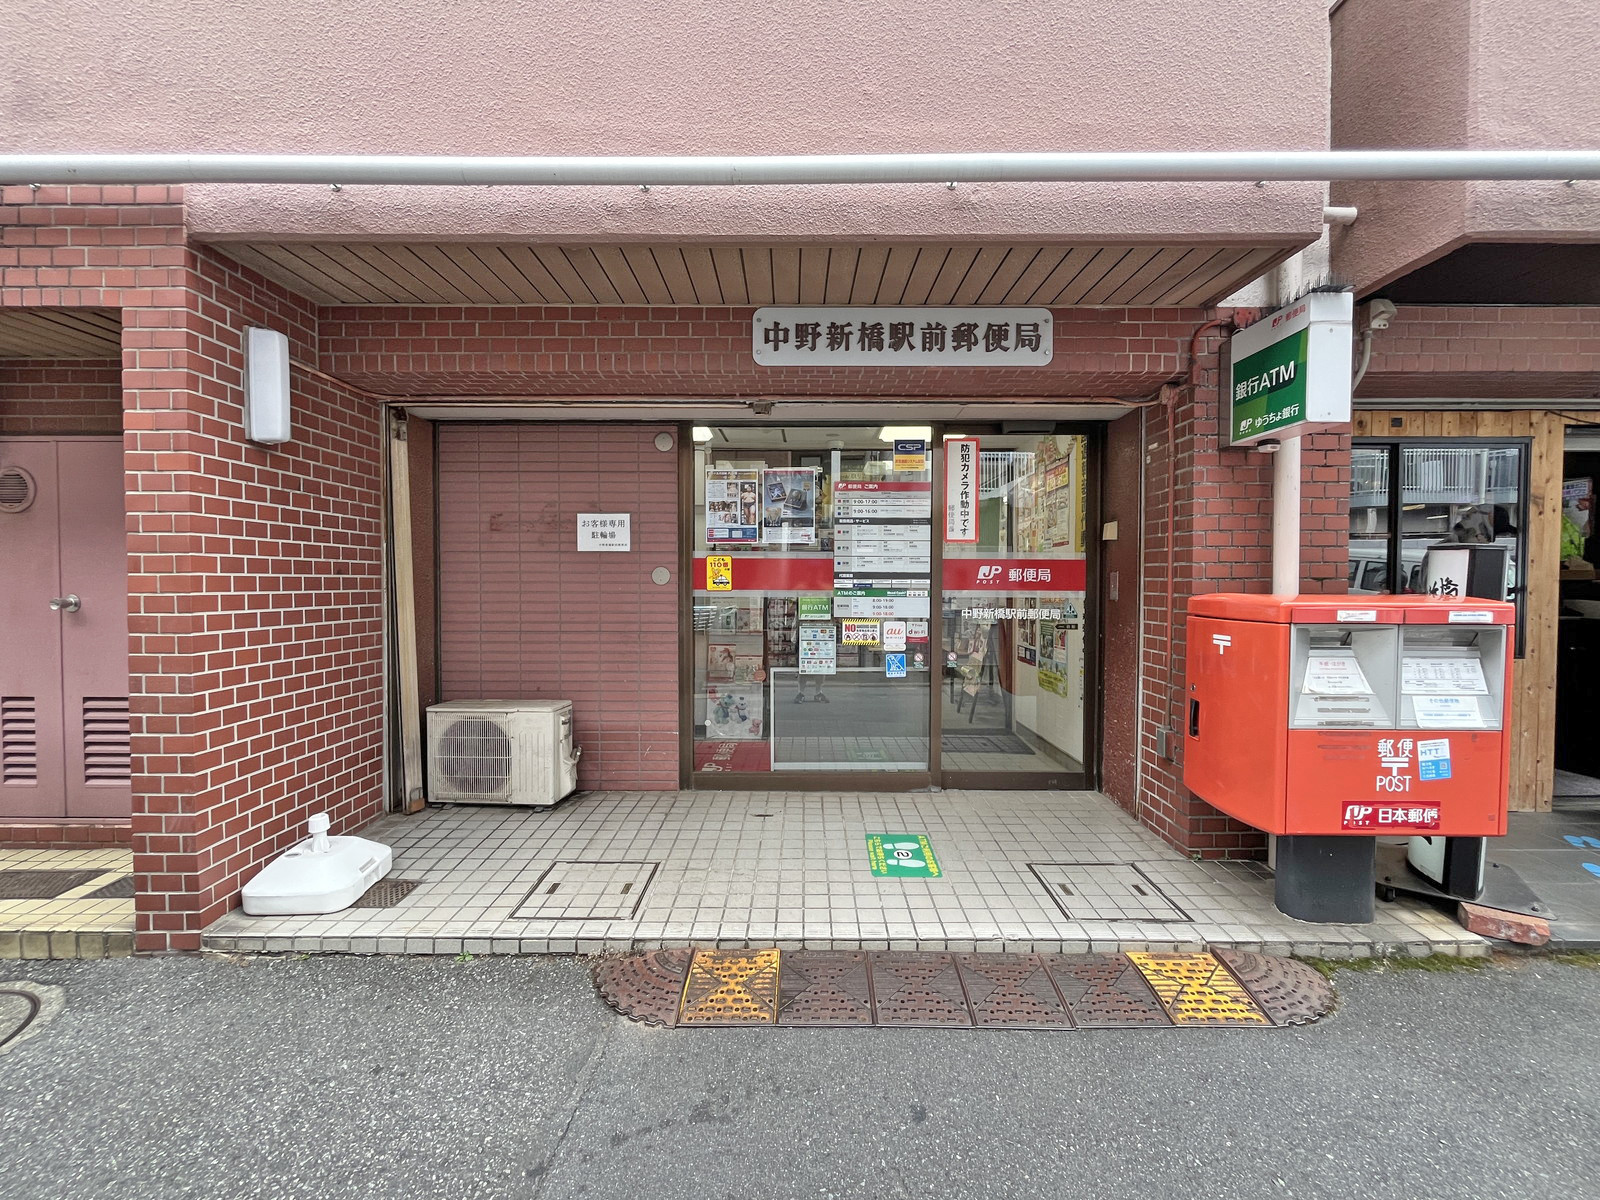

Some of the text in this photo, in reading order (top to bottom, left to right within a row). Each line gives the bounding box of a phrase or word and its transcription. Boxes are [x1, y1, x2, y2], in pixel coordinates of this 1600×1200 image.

[1285, 304, 1306, 322] 郵便局
[763, 321, 1042, 353] 中野新橋駅前郵便局
[1235, 360, 1296, 401] 銀行ATM
[1254, 403, 1300, 428] ゆうちょ銀行
[897, 443, 922, 451] CSP
[960, 443, 971, 537] 防犯カメラ作動中です
[581, 519, 625, 528] お客様専用
[591, 531, 616, 539] 駐輪場
[1008, 568, 1051, 583] 郵便局
[961, 607, 1061, 620] 中野新橋駅前郵便局
[844, 624, 856, 632] NO
[1377, 738, 1414, 758] 郵便
[1420, 748, 1440, 756] HTT
[1376, 775, 1412, 792] POST
[1378, 807, 1438, 826] 日本郵便
